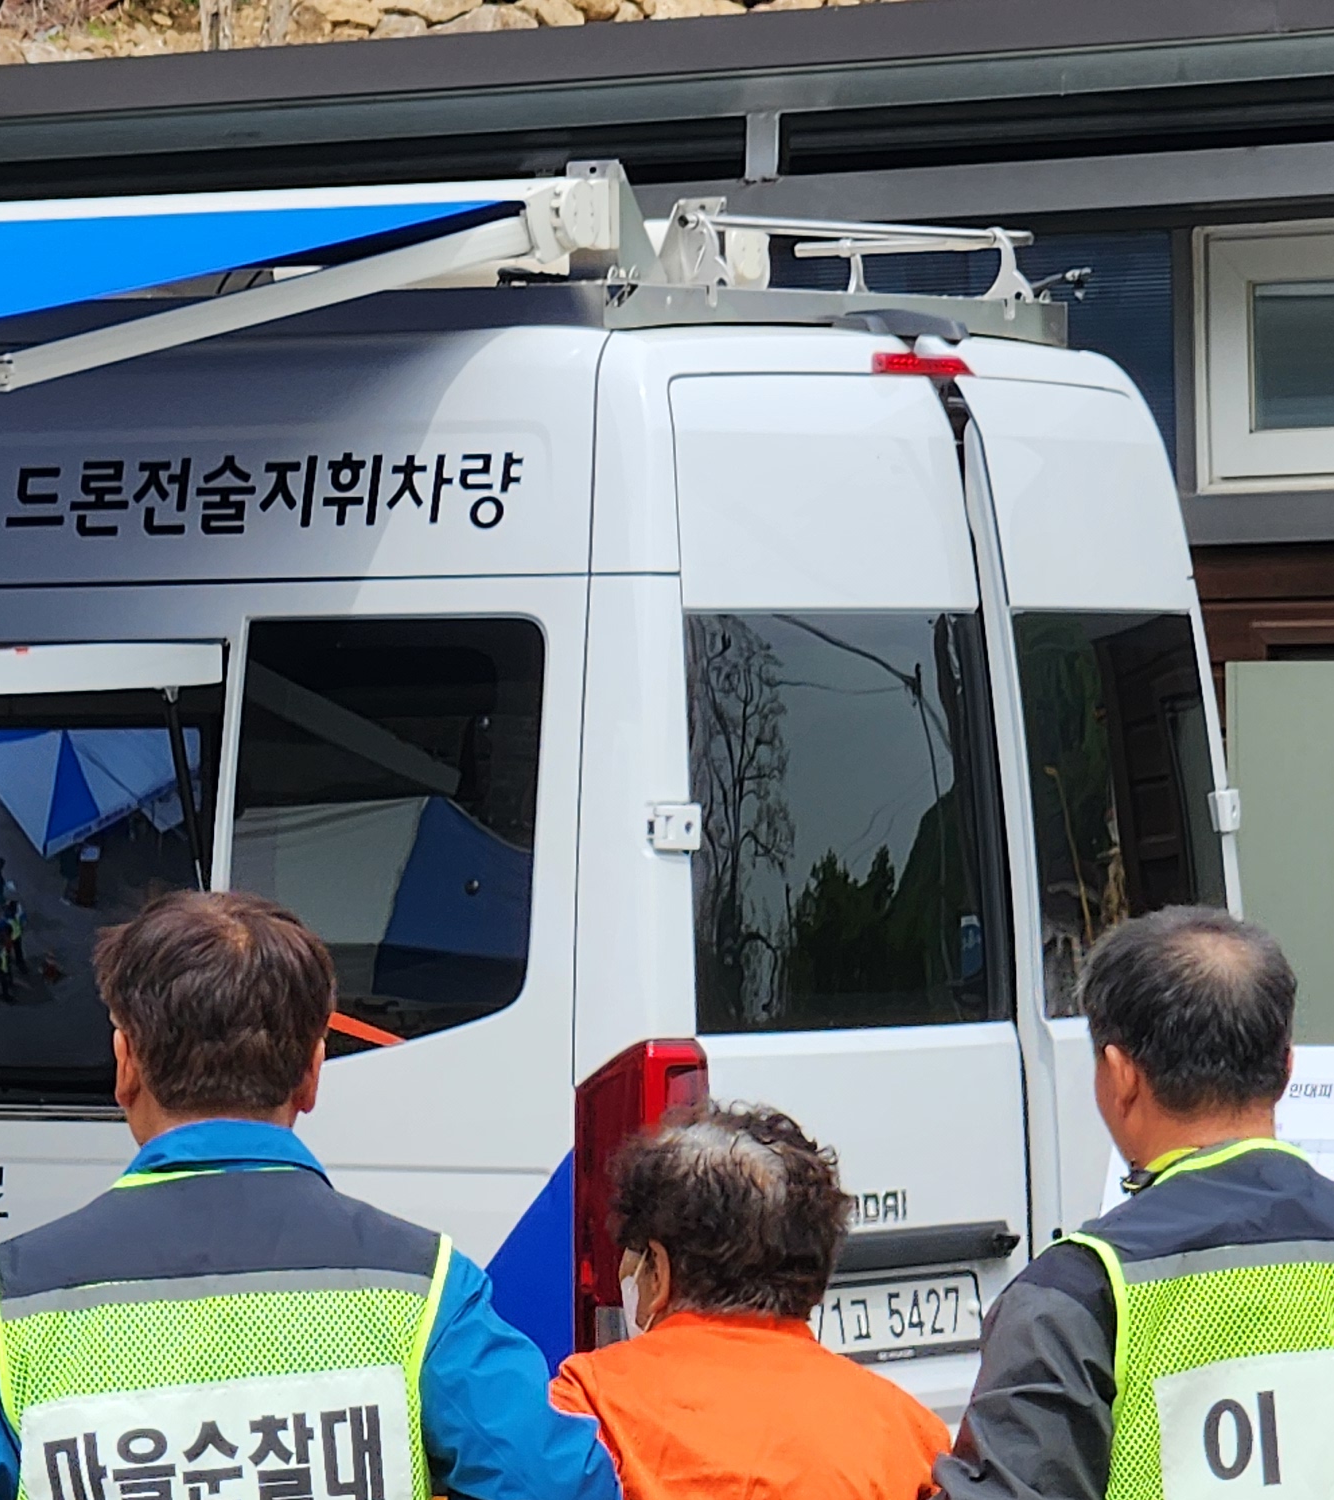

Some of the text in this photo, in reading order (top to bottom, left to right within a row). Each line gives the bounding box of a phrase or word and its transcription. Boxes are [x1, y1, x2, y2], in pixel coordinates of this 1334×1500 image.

[5, 451, 524, 538] 드론전술지휘차량
[887, 1286, 961, 1338] 5427
[1203, 1390, 1282, 1487] 이
